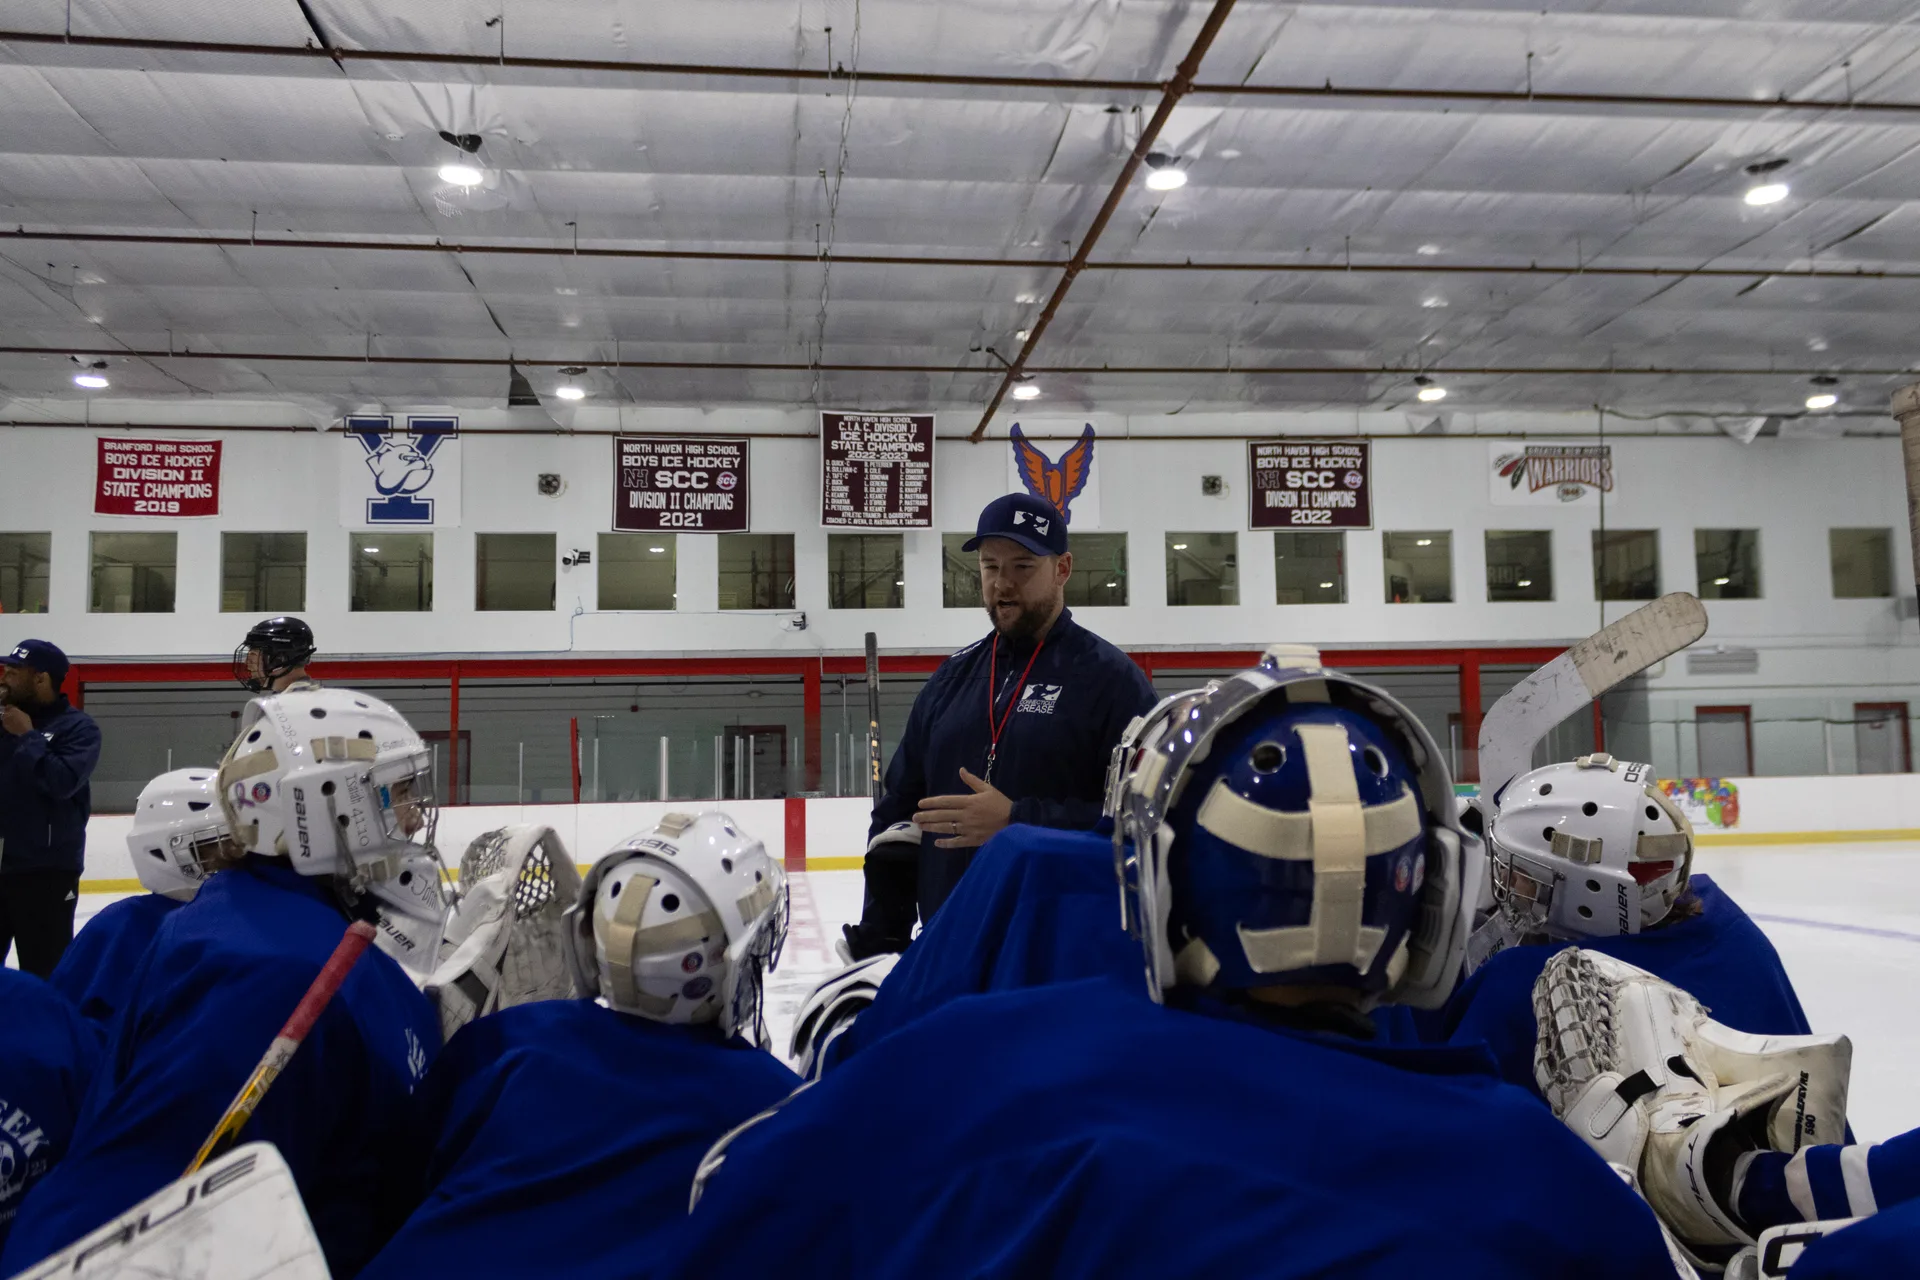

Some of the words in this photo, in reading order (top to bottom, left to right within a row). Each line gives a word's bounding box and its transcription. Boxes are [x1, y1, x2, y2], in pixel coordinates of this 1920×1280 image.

[875, 423, 907, 432] DIVISION
[911, 424, 917, 433] II
[841, 432, 861, 440] ICE
[864, 433, 915, 442] HOCKEY
[104, 442, 152, 451] BRANFORD
[155, 444, 176, 452] HIGH
[623, 444, 651, 453] NORTH
[655, 444, 682, 453] HAVEN
[685, 445, 704, 454] HIGH
[707, 446, 740, 455] SCHOOL
[831, 440, 864, 450] STATE
[868, 442, 924, 452] CHAMPIONS
[1257, 446, 1282, 456] NORTH
[1284, 446, 1309, 456] HAVEN
[1312, 446, 1329, 455] HIGH
[1332, 446, 1361, 456] SCHOOL
[105, 453, 138, 465] BOYS
[142, 455, 161, 466] ICE
[165, 456, 212, 467] HOCKEY
[623, 455, 658, 466] BOYS
[662, 456, 683, 467] ICE
[687, 457, 740, 468] HOCKEY
[848, 451, 908, 459] 2022-2023
[1257, 457, 1288, 468] BOYS
[1292, 457, 1311, 468] ICE
[1315, 458, 1362, 468] HOCKEY
[114, 468, 184, 481] DIVISION
[191, 470, 203, 480] II
[655, 471, 708, 489] SCC
[1286, 471, 1335, 488] SCC
[1527, 457, 1613, 493] WARRIORS
[103, 481, 141, 497] STATE
[144, 483, 212, 498] CHAMPIONS
[630, 491, 666, 509] DIVISION
[670, 493, 680, 509] II
[684, 493, 733, 510] CHAMPIONS
[1266, 491, 1298, 507] DIVISION
[1301, 491, 1309, 507] II
[1312, 491, 1356, 508] CHAMPIONS
[135, 501, 180, 513] 2019
[660, 512, 703, 527] 2021
[1291, 509, 1332, 523] 2022
[1016, 704, 1055, 714] CREASE
[293, 786, 311, 858] BAUER
[378, 917, 416, 951] AUER
